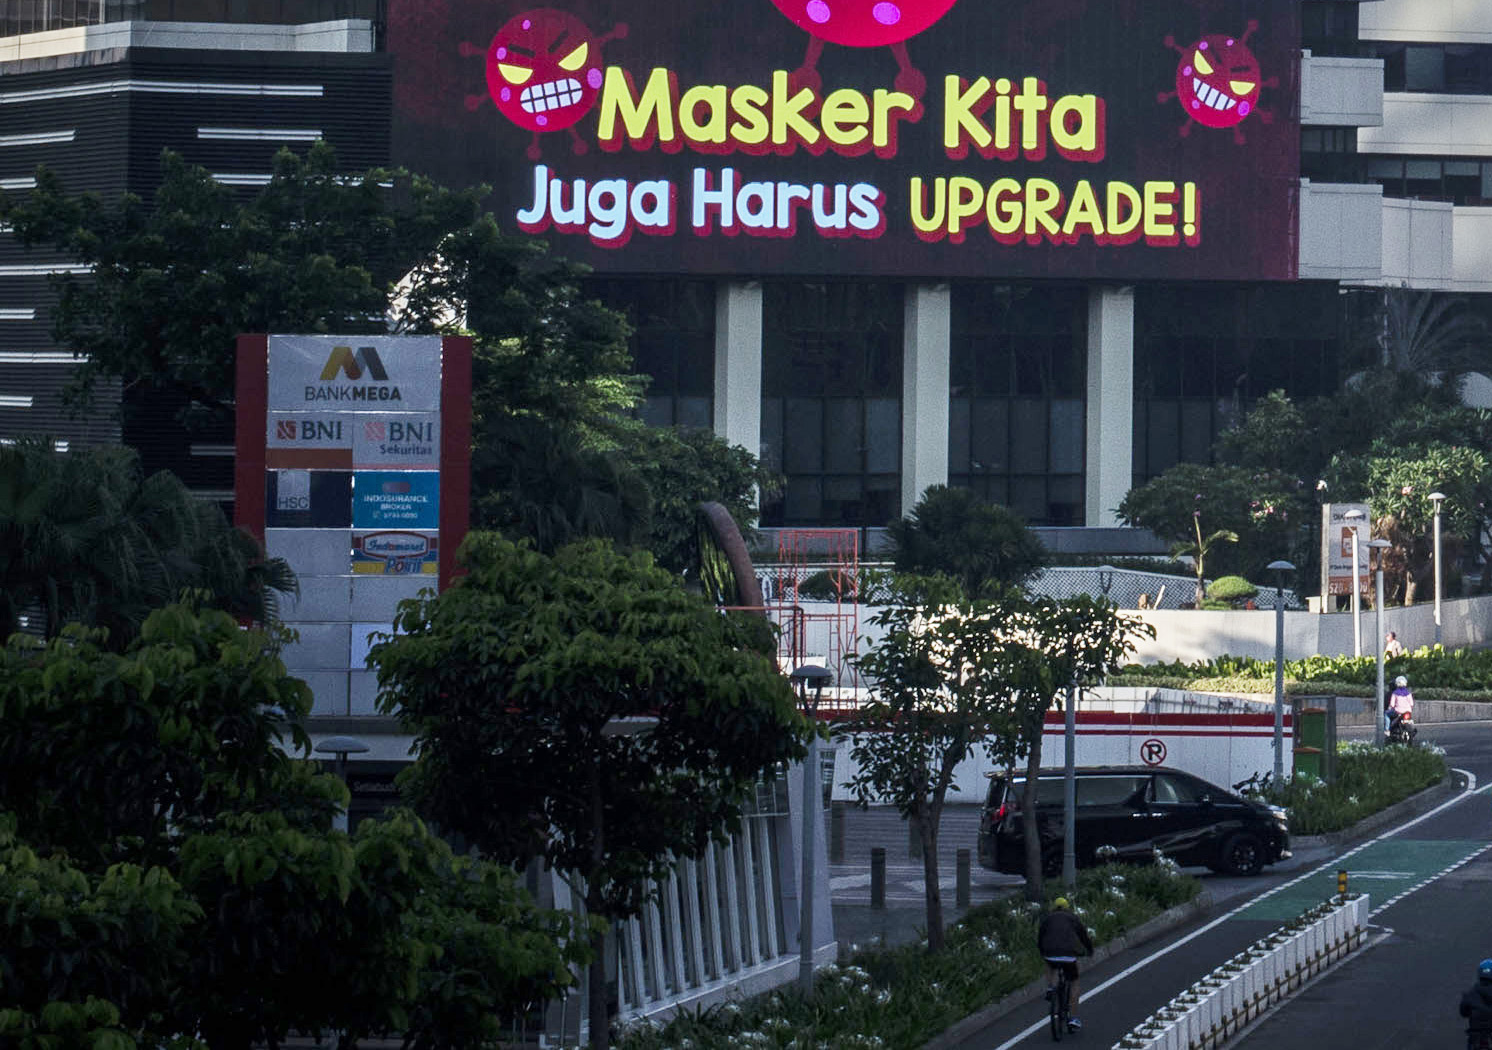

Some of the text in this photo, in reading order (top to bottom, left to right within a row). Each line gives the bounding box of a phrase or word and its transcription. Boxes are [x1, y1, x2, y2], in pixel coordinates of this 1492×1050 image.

[597, 66, 1097, 152] Masker Kita
[516, 165, 1197, 240] Juga Harus UPGRADE!
[301, 421, 342, 440] BNI
[389, 422, 433, 442] BNI
[379, 444, 433, 456] Sekuritas
[363, 495, 429, 503] INDOSURANCE
[380, 503, 412, 511] BROKER
[367, 537, 424, 552] Indomaret
[385, 557, 422, 575] Point
